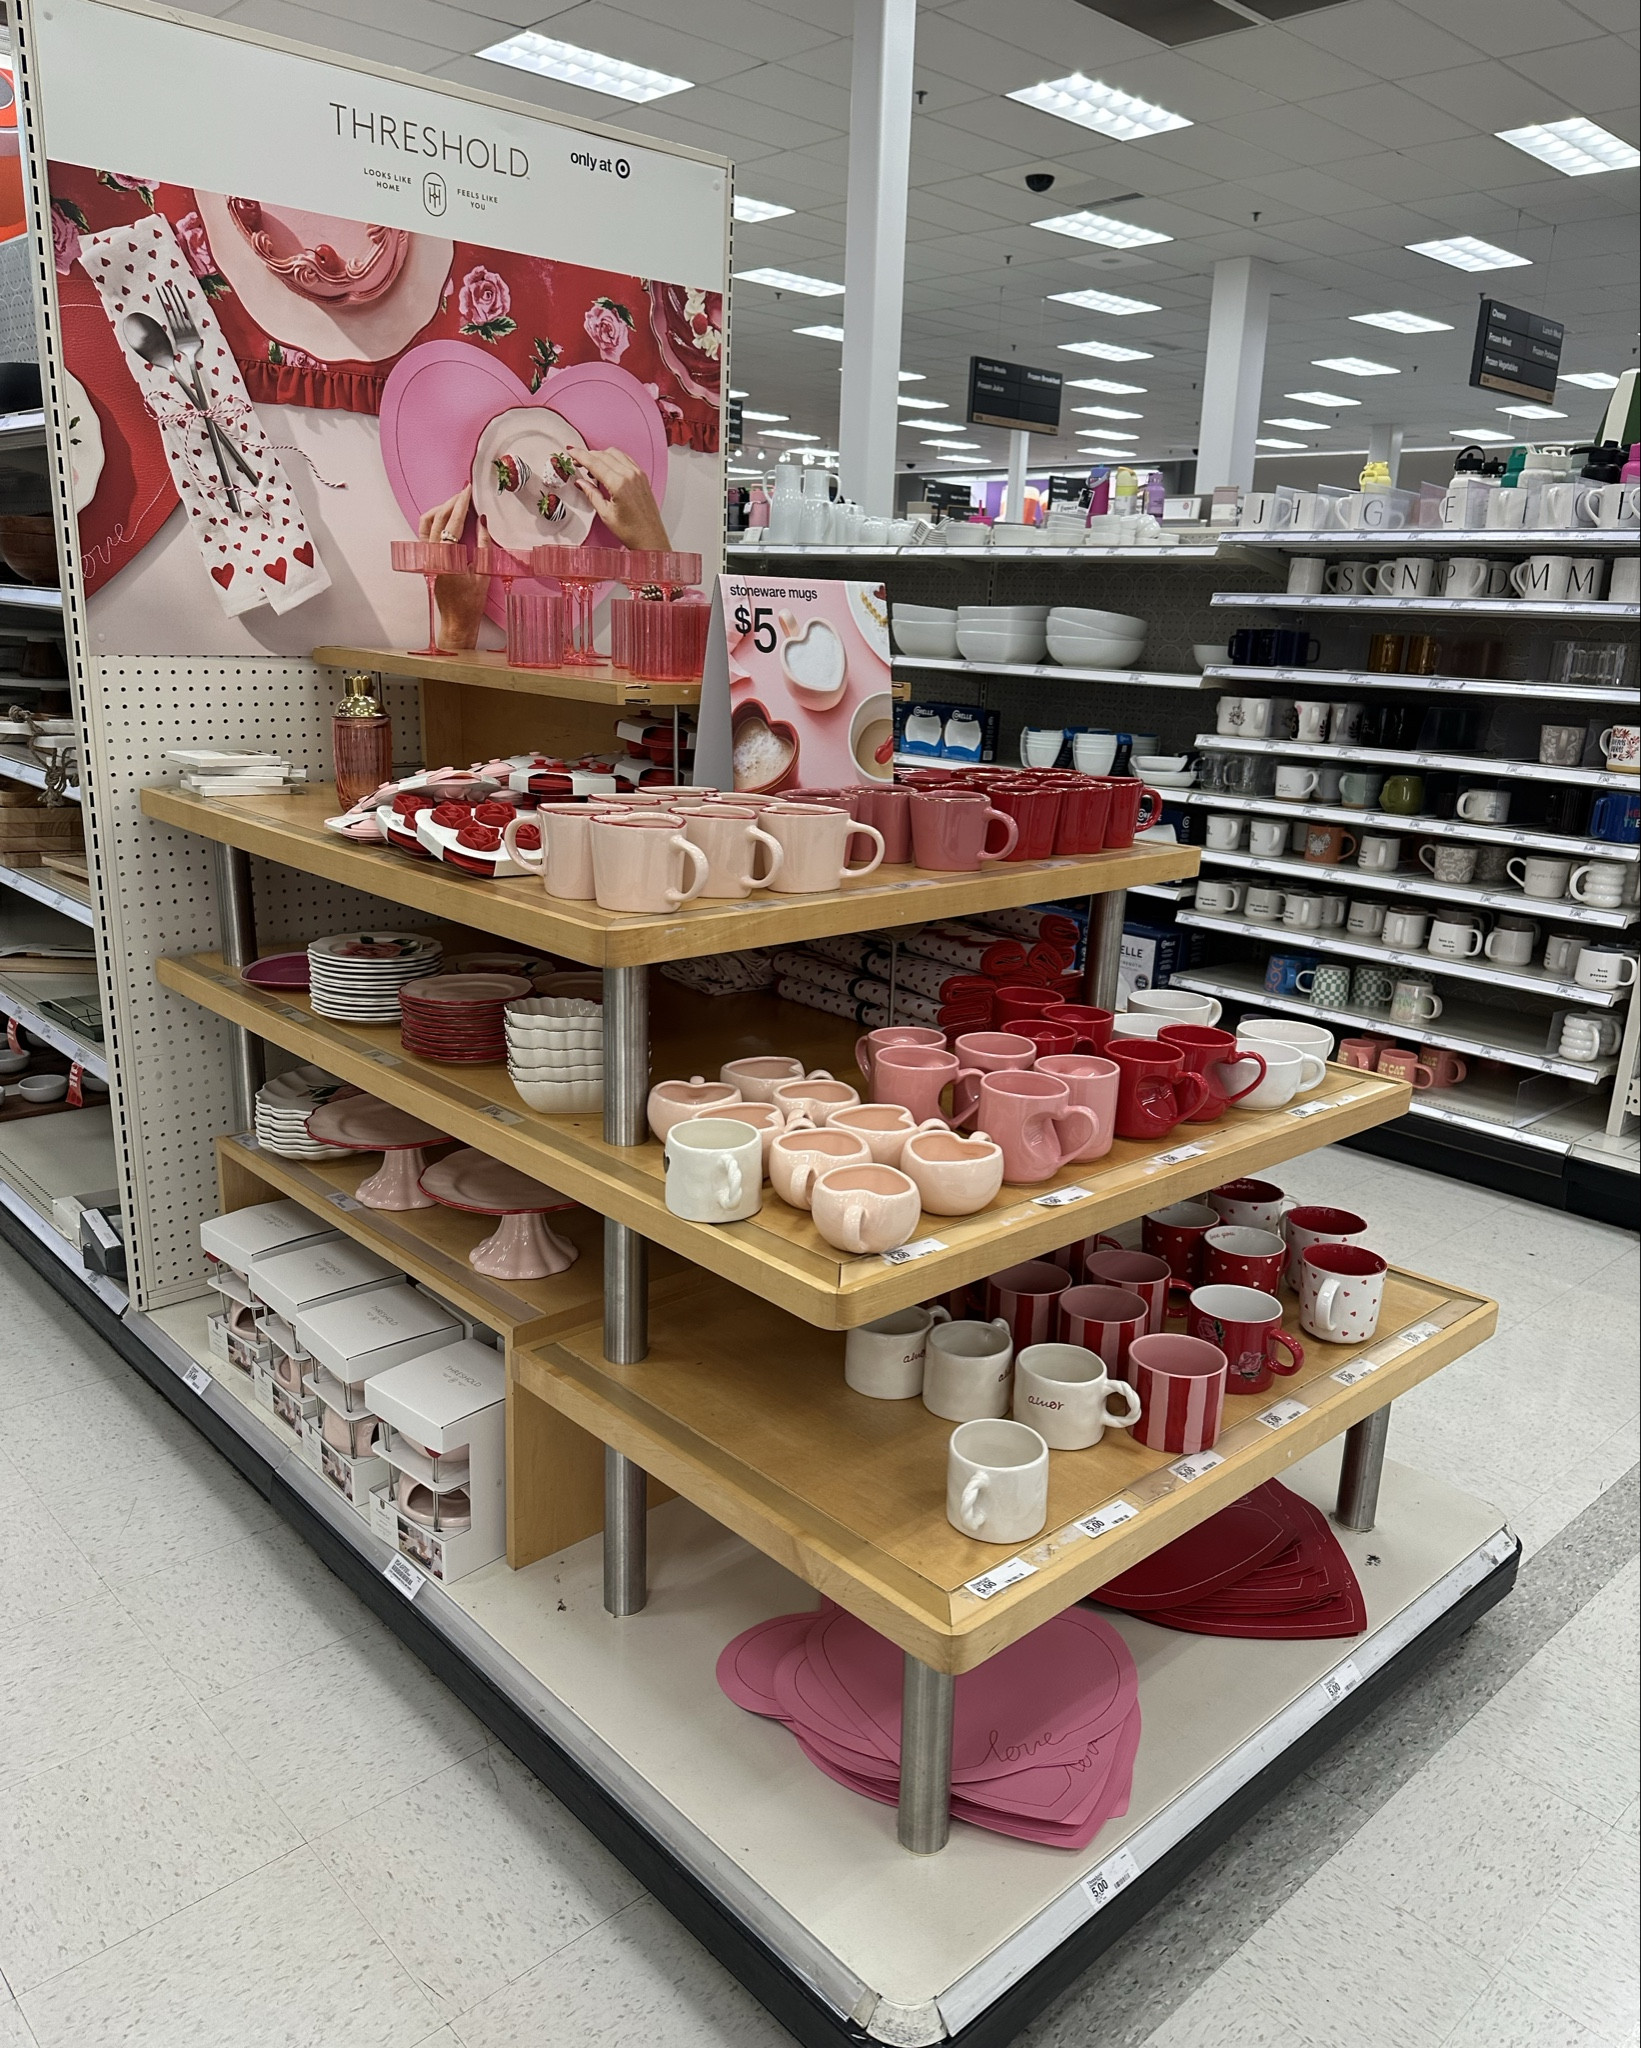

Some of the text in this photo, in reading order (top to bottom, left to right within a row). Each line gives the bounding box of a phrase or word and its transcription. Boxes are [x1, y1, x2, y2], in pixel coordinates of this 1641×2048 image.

[329, 102, 529, 178] THRESHOLD
[570, 150, 612, 173] only at
[363, 167, 412, 185] LOOKS LIKE
[376, 181, 400, 192] HOME
[457, 188, 499, 203] FEELS LIKE
[470, 201, 486, 211] YOU
[1253, 499, 1265, 525] J
[1364, 500, 1384, 526] G
[1444, 496, 1456, 523] E
[81, 523, 128, 578] ove
[1340, 567, 1354, 592] S
[1401, 564, 1420, 590] N
[1487, 568, 1508, 594] D
[1526, 563, 1550, 591] M
[1566, 566, 1595, 594] M
[730, 584, 818, 601] stoneware mugs
[735, 605, 777, 654] $5
[1388, 1065, 1406, 1076] CAT
[444, 1365, 482, 1388] THRESHOLD
[1179, 1466, 1196, 1478] 5.00
[1085, 1520, 1105, 1532] 5.00
[976, 1581, 997, 1594] 5.00
[1328, 1682, 1341, 1697] 5.00
[985, 1730, 1057, 1763] love
[1091, 1879, 1108, 1898] 5.00
